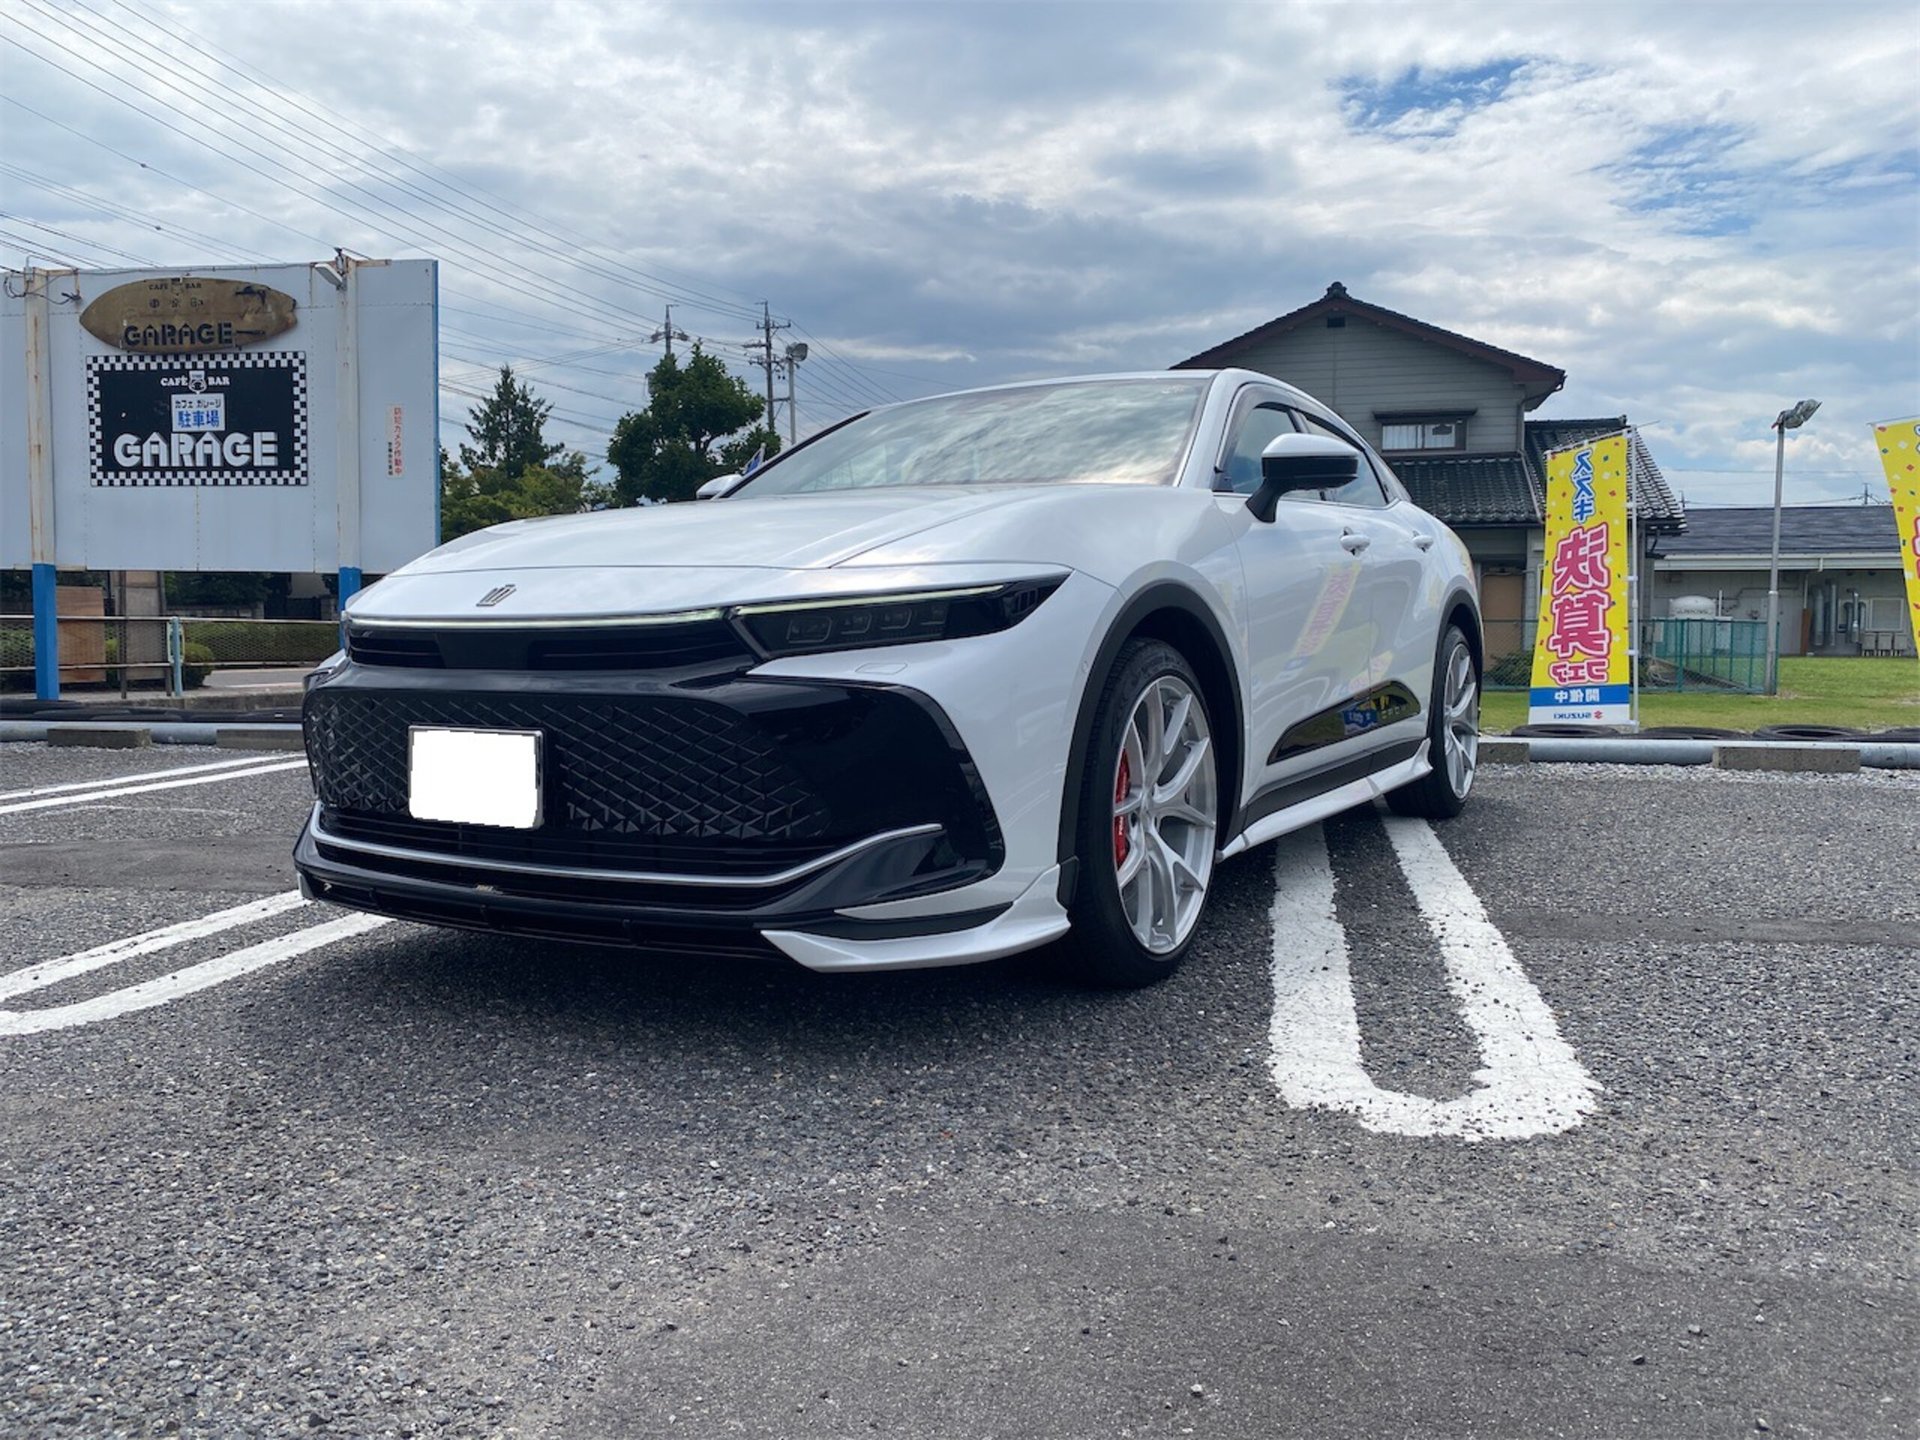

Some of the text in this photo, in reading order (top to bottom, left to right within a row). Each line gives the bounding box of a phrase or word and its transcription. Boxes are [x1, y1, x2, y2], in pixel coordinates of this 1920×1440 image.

[124, 322, 233, 346] GARAGE
[207, 376, 231, 386] BAR
[174, 399, 194, 409] カフェ
[177, 409, 220, 428] 駐車場
[113, 430, 279, 468] GARAGE
